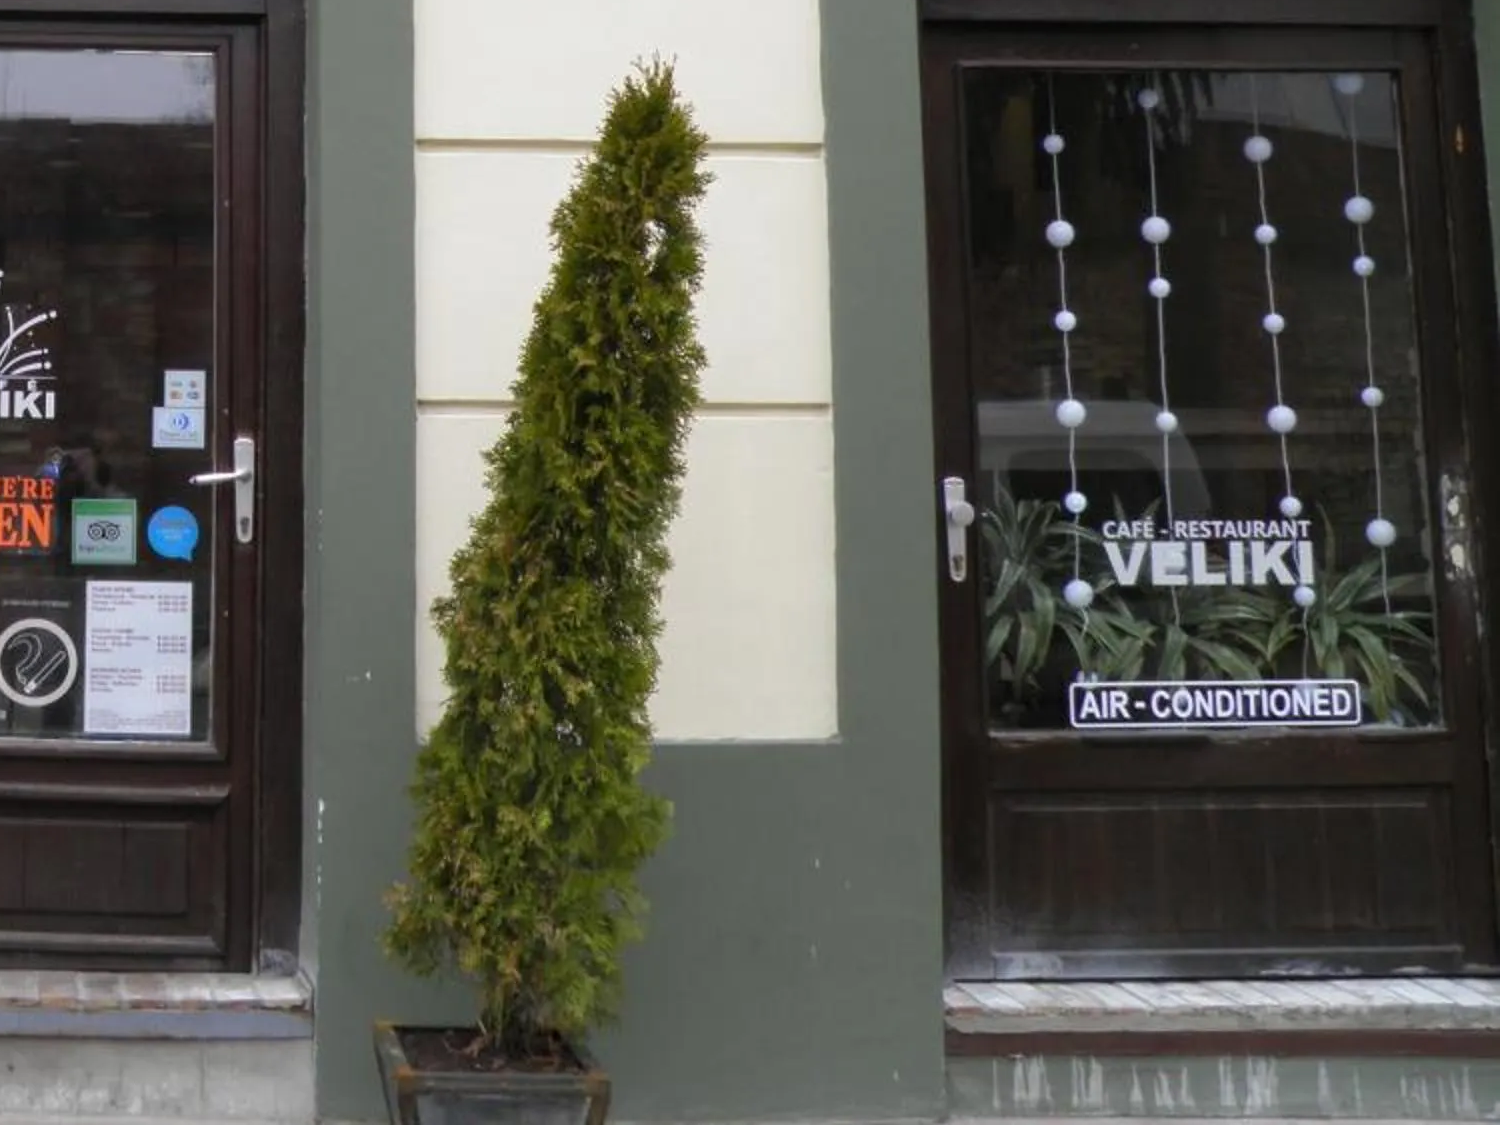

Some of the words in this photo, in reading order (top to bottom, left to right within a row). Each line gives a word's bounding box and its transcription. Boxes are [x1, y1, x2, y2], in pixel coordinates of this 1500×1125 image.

[1103, 516, 1154, 539] CAFÉ
[1175, 521, 1311, 539] RESTAURANT
[1103, 541, 1315, 586] VELIKI
